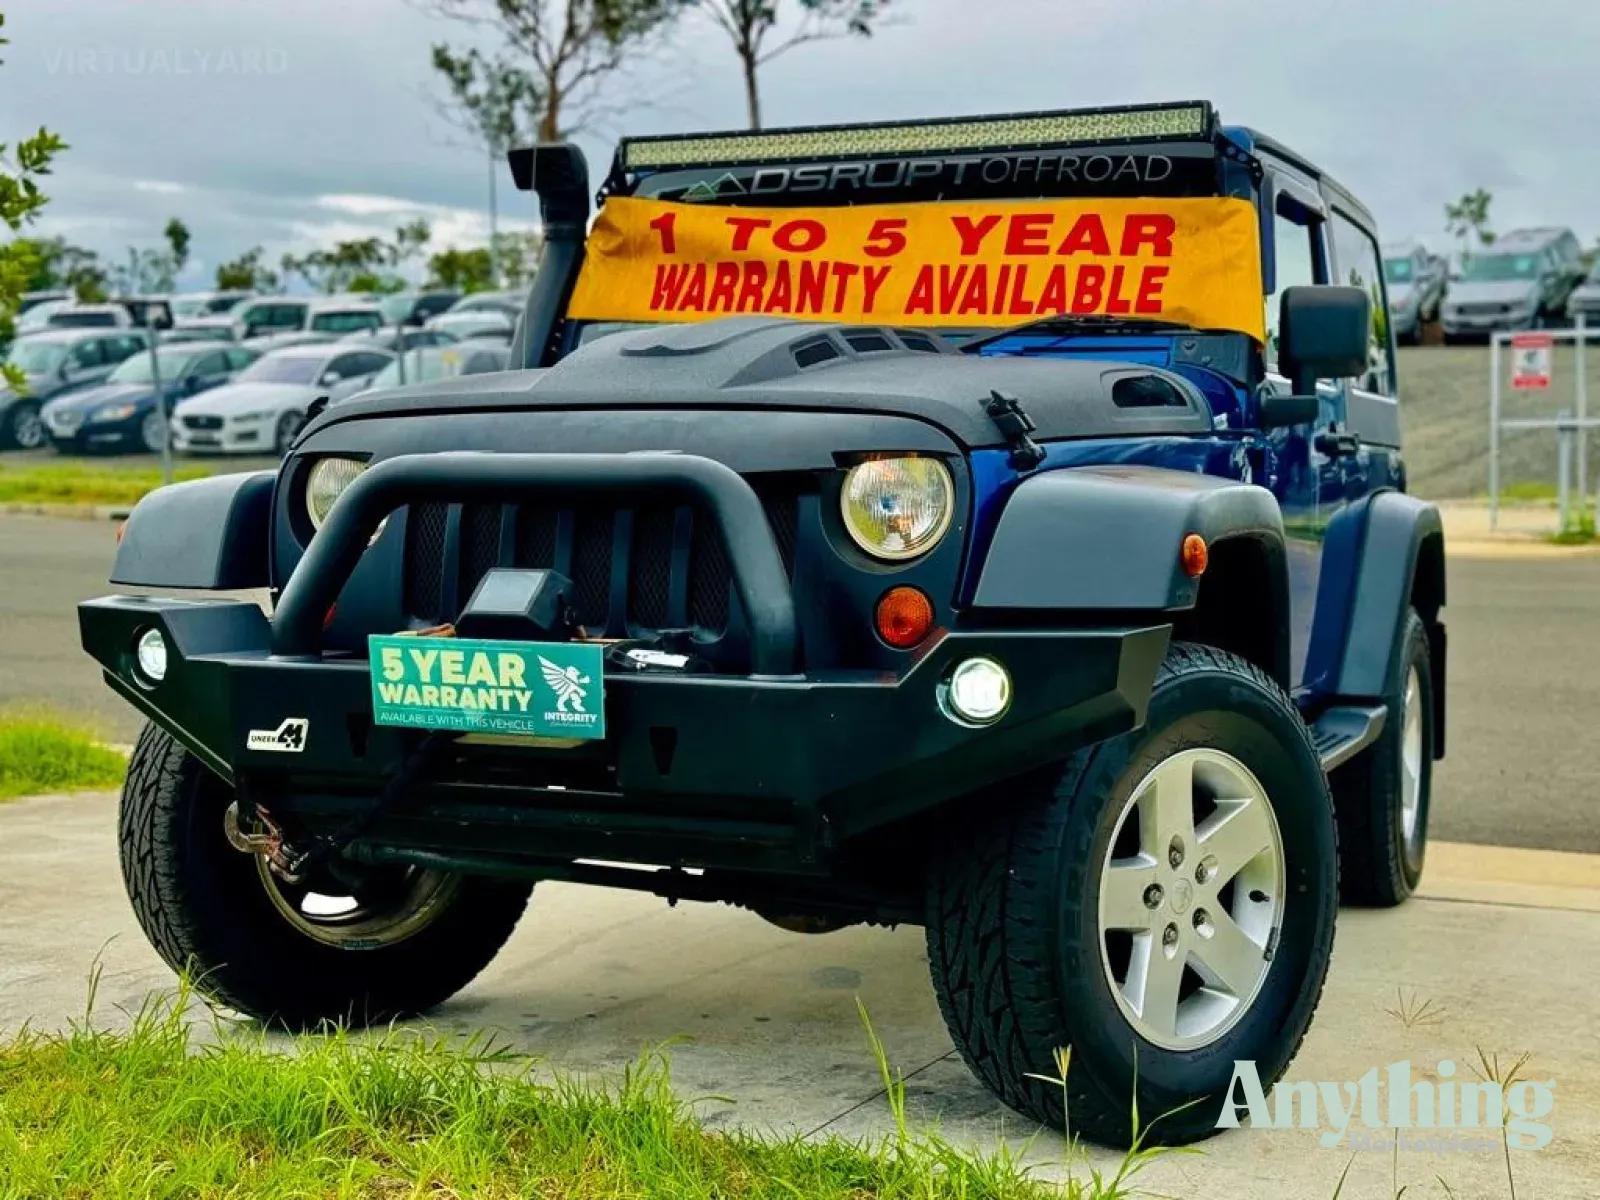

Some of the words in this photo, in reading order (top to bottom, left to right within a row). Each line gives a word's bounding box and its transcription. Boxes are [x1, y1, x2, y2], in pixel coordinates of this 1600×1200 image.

[650, 212, 676, 254] 1
[725, 217, 827, 253] TO
[863, 218, 908, 258] 5
[951, 213, 1176, 257] YEAR
[649, 259, 892, 314] WARRANTY
[904, 263, 1170, 315] AVAILABLE
[382, 648, 405, 682] 5
[409, 649, 527, 688] YEAR
[378, 682, 534, 712] WARRANTY
[380, 711, 435, 725] AVAILABLE
[435, 714, 463, 726] WITH
[465, 716, 489, 728] THIS
[490, 718, 535, 731] VEHICLE
[543, 711, 598, 723] INTEGRITY
